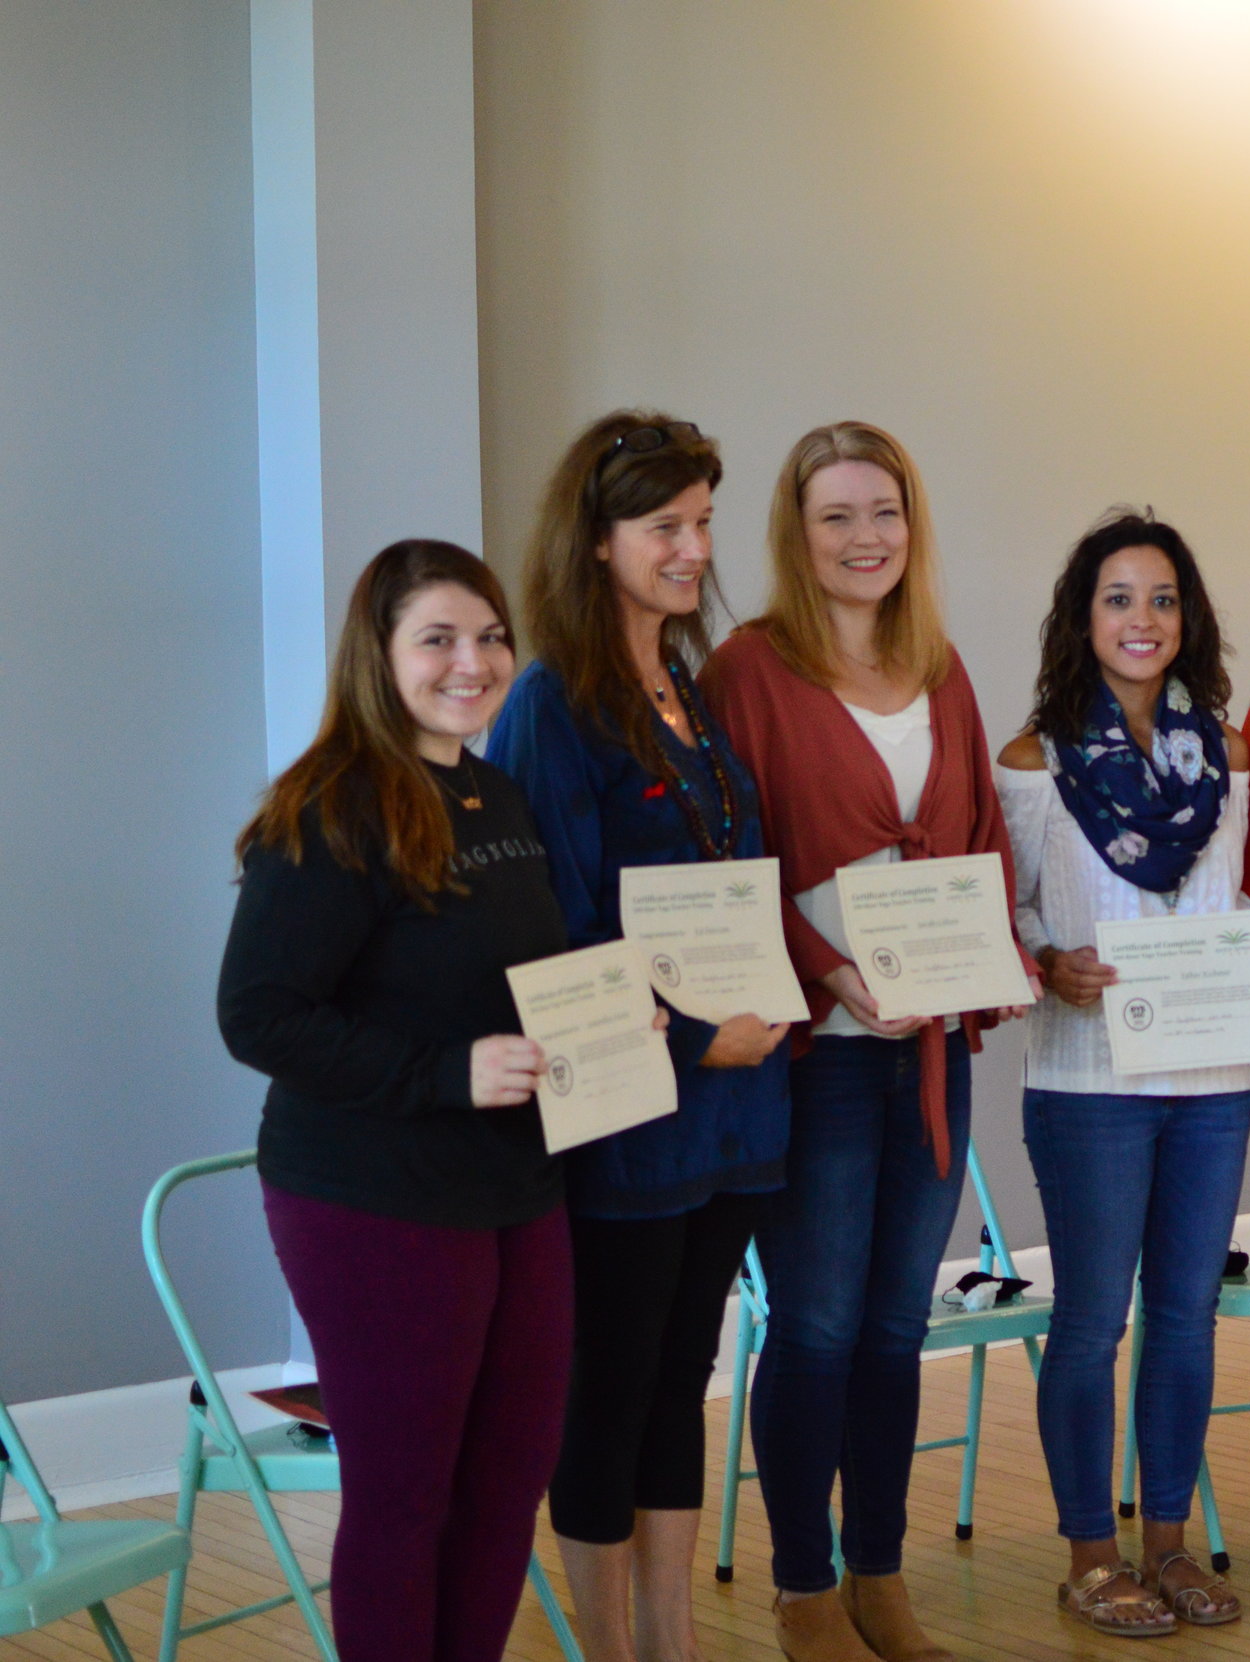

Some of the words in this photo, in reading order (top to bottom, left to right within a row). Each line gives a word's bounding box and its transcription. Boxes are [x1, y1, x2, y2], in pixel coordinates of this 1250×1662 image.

[1112, 944, 1152, 953] Certificate
[1154, 942, 1162, 950] of
[1163, 939, 1206, 948] Completion
